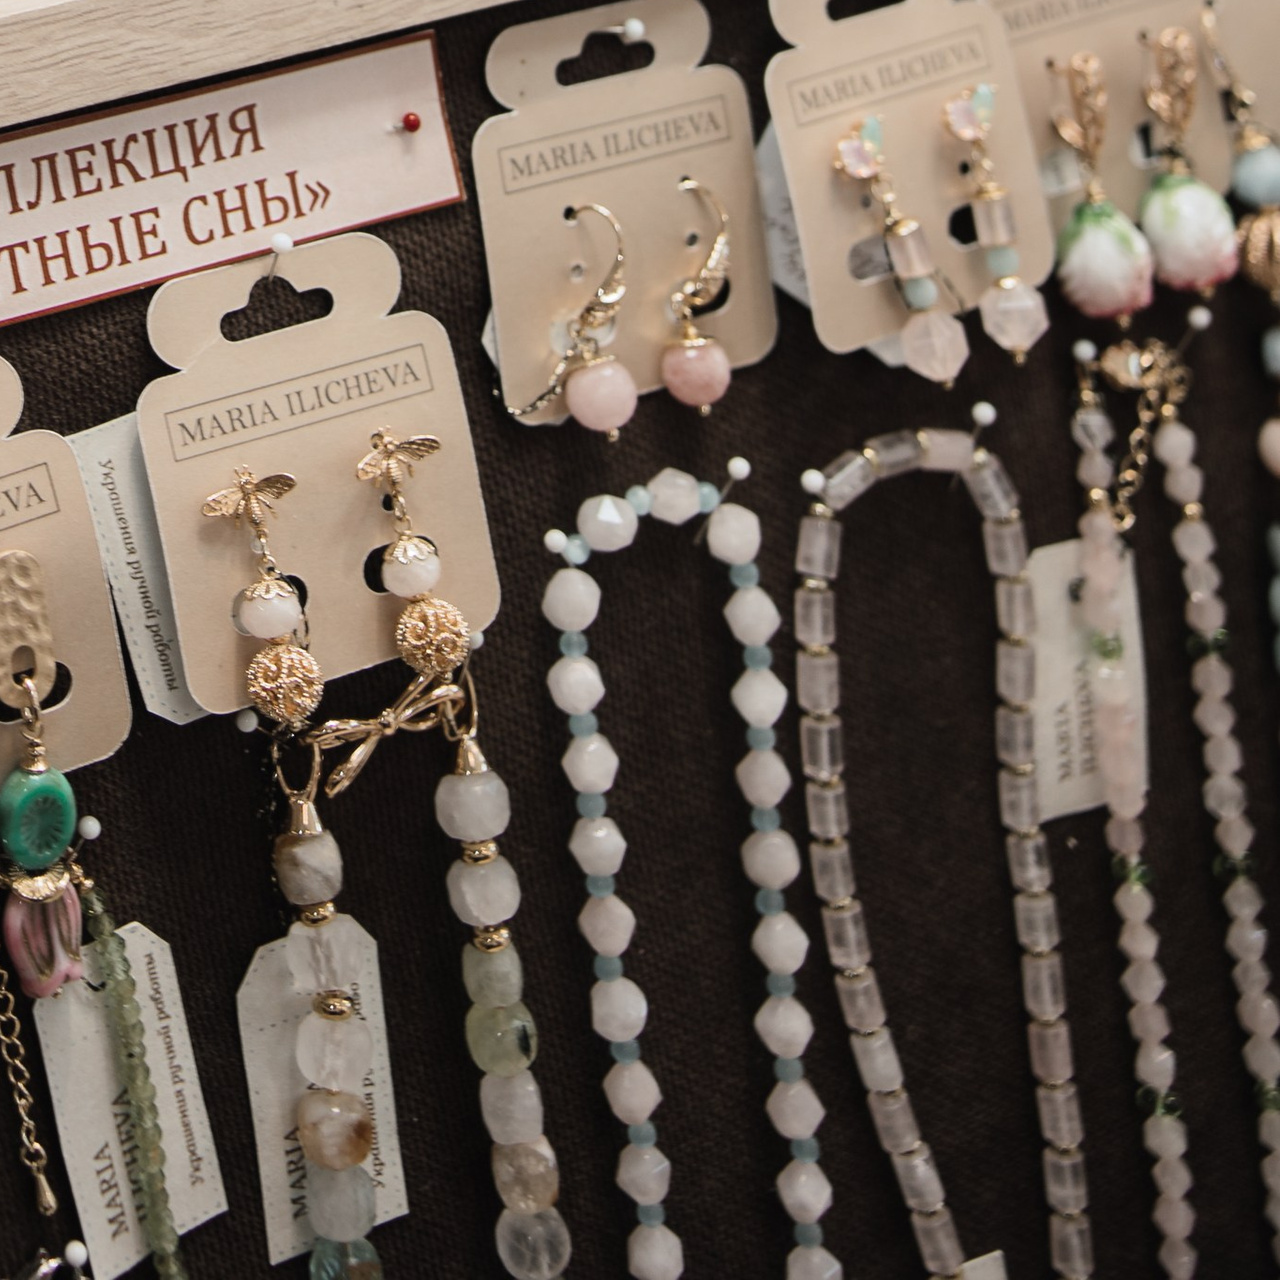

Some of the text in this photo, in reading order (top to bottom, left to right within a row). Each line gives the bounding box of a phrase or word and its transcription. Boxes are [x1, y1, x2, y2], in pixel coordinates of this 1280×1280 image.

[797, 41, 983, 112] MARIA ILICHEVA
[509, 109, 722, 181] MARIA ILICHEVA
[181, 170, 331, 246] СНЫ»
[177, 360, 422, 447] MARIA ILICHEVA
[97, 458, 180, 693] Украшения ручной работы
[143, 952, 205, 1188] Украшения ручной работы
[94, 1141, 130, 1242] MARIA
[283, 1126, 310, 1220] MARIA
